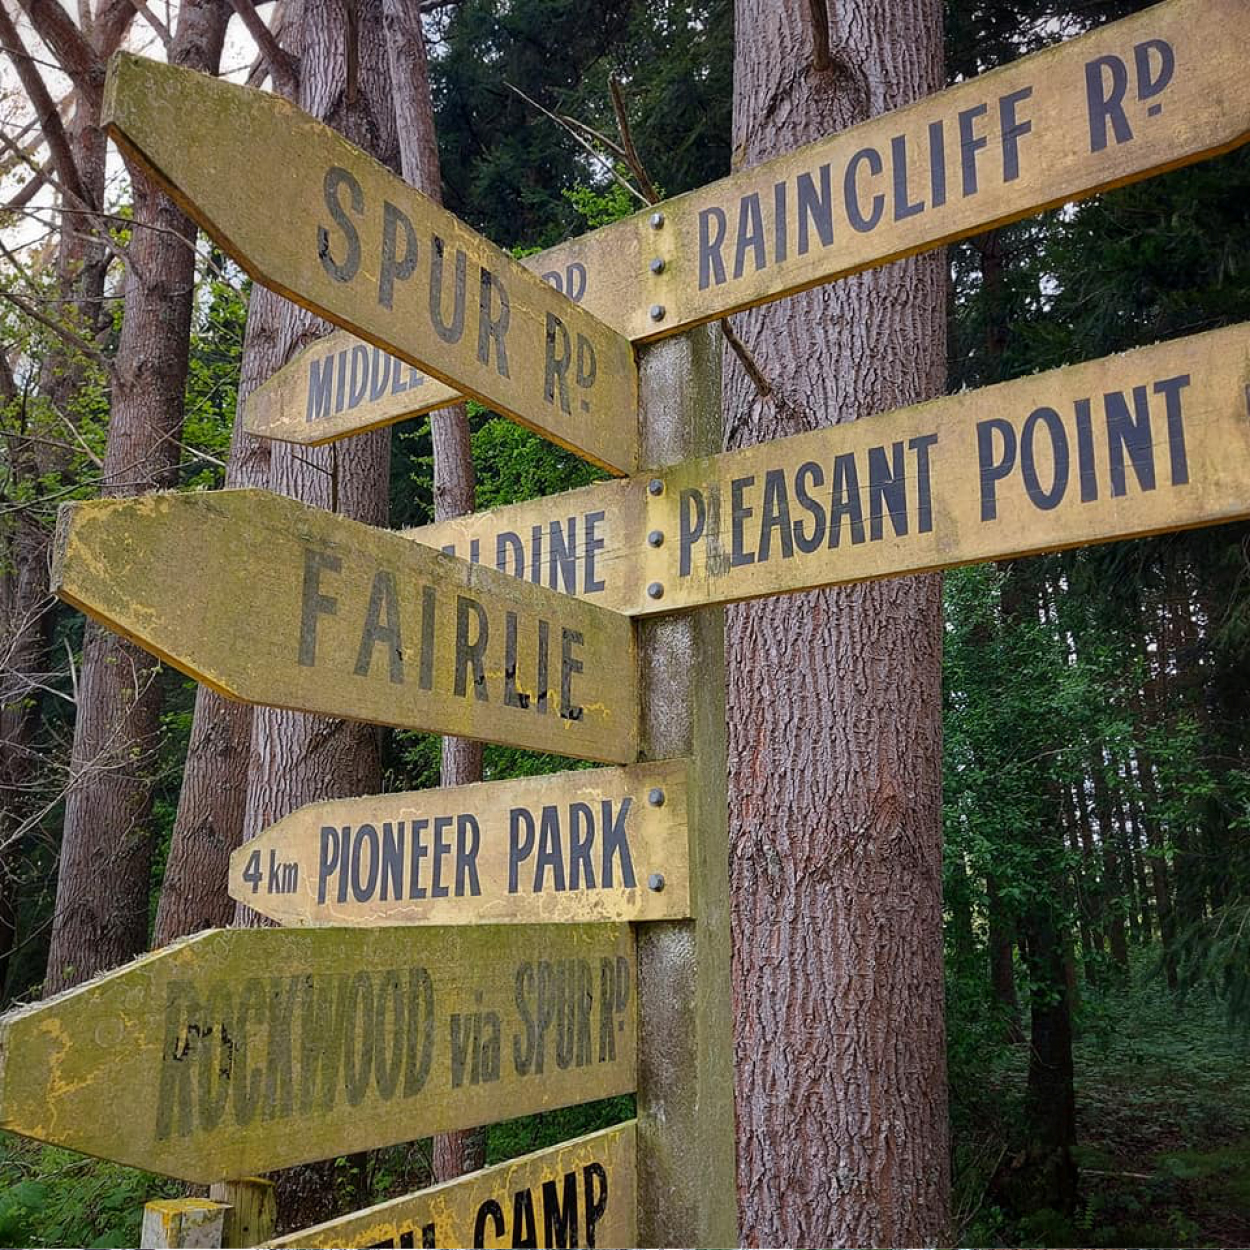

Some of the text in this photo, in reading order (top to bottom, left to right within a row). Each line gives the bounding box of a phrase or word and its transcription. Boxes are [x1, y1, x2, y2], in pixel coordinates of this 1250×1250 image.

[318, 166, 511, 380] SPUR
[699, 86, 1033, 291] RAINCLIFF
[442, 510, 605, 595] DINE
[679, 374, 1190, 578] PLEASANT POINT
[298, 549, 585, 721] FAIRLIE
[317, 813, 481, 904] PIONEER
[508, 796, 638, 893] PARK
[450, 990, 500, 1089] via
[514, 957, 593, 1078] SPUR
